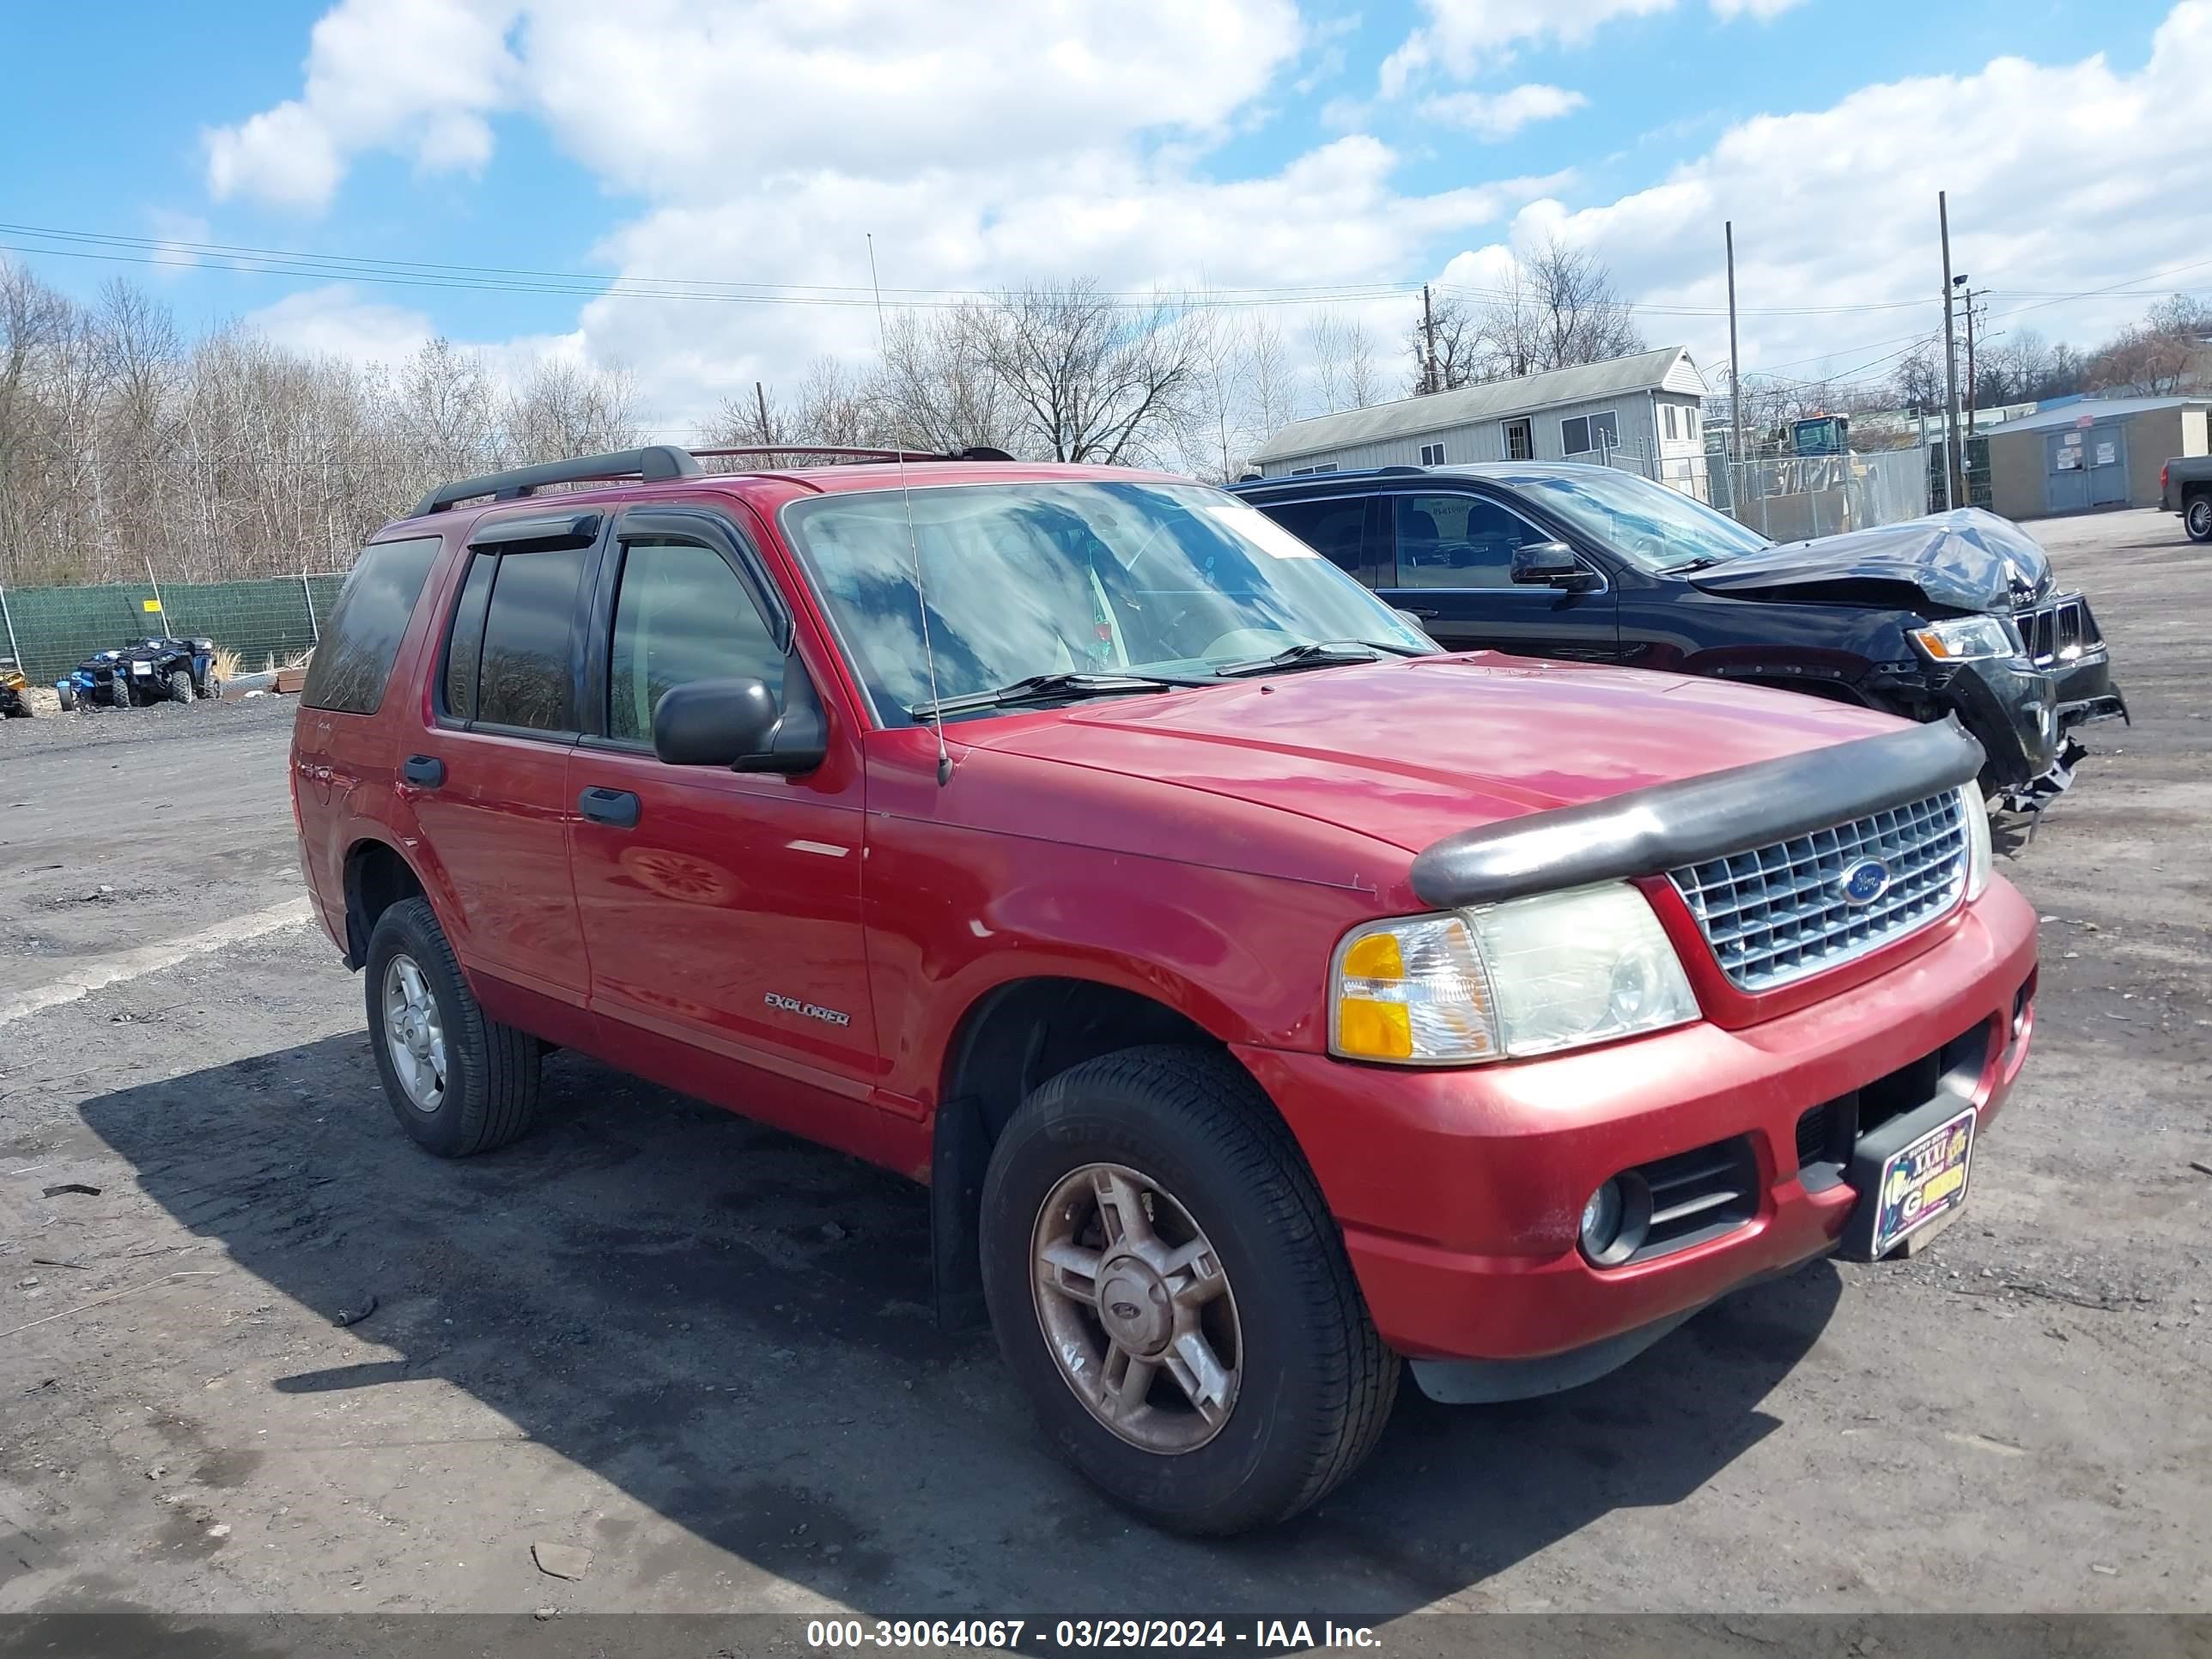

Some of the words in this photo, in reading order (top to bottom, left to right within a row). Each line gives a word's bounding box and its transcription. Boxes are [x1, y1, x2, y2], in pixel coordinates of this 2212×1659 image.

[764, 991, 851, 1026] EXPLORER
[1908, 1139, 1931, 1159] SUPER
[1902, 1190, 1923, 1218] G
